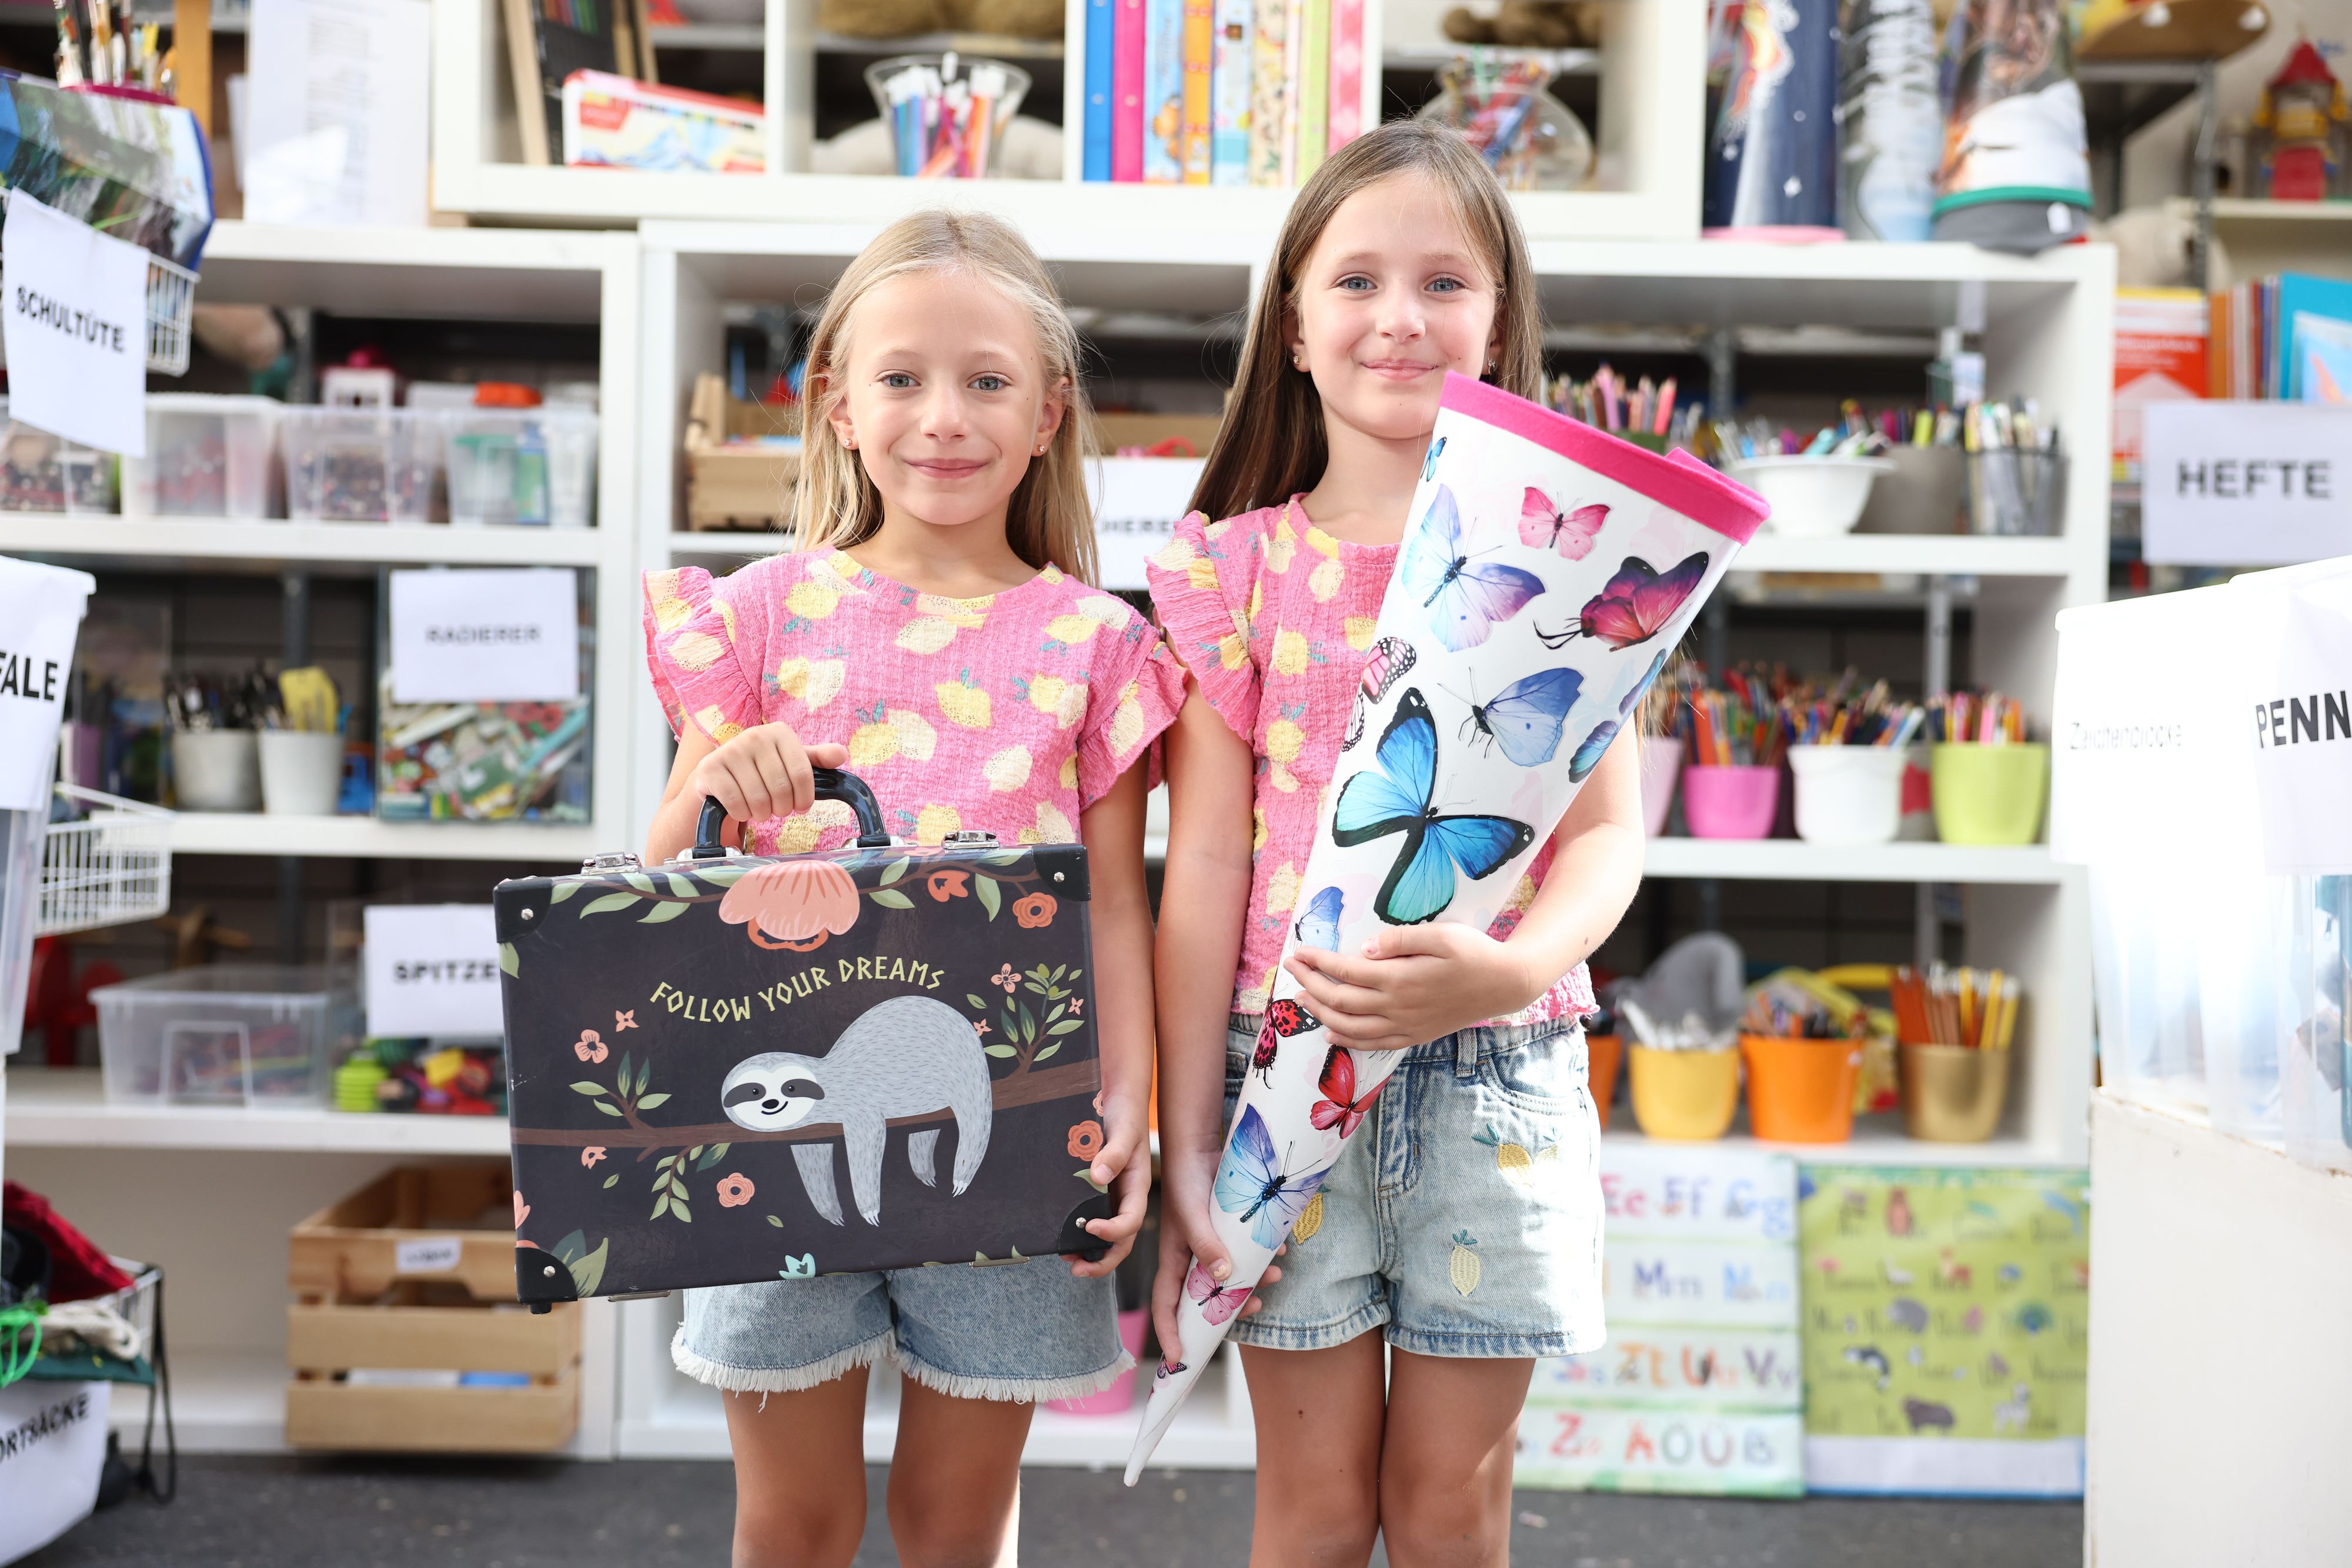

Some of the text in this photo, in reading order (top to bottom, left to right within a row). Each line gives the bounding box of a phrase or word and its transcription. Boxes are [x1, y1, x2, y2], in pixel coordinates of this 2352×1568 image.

[17, 286, 124, 353] SCHULTÜTE
[2177, 459, 2333, 499] HEFTE
[426, 626, 540, 646] RADIERER
[2256, 690, 2351, 748] PENN
[394, 959, 499, 984] SPITZE
[650, 956, 945, 1023] FOLLOW YOUR DREAMS
